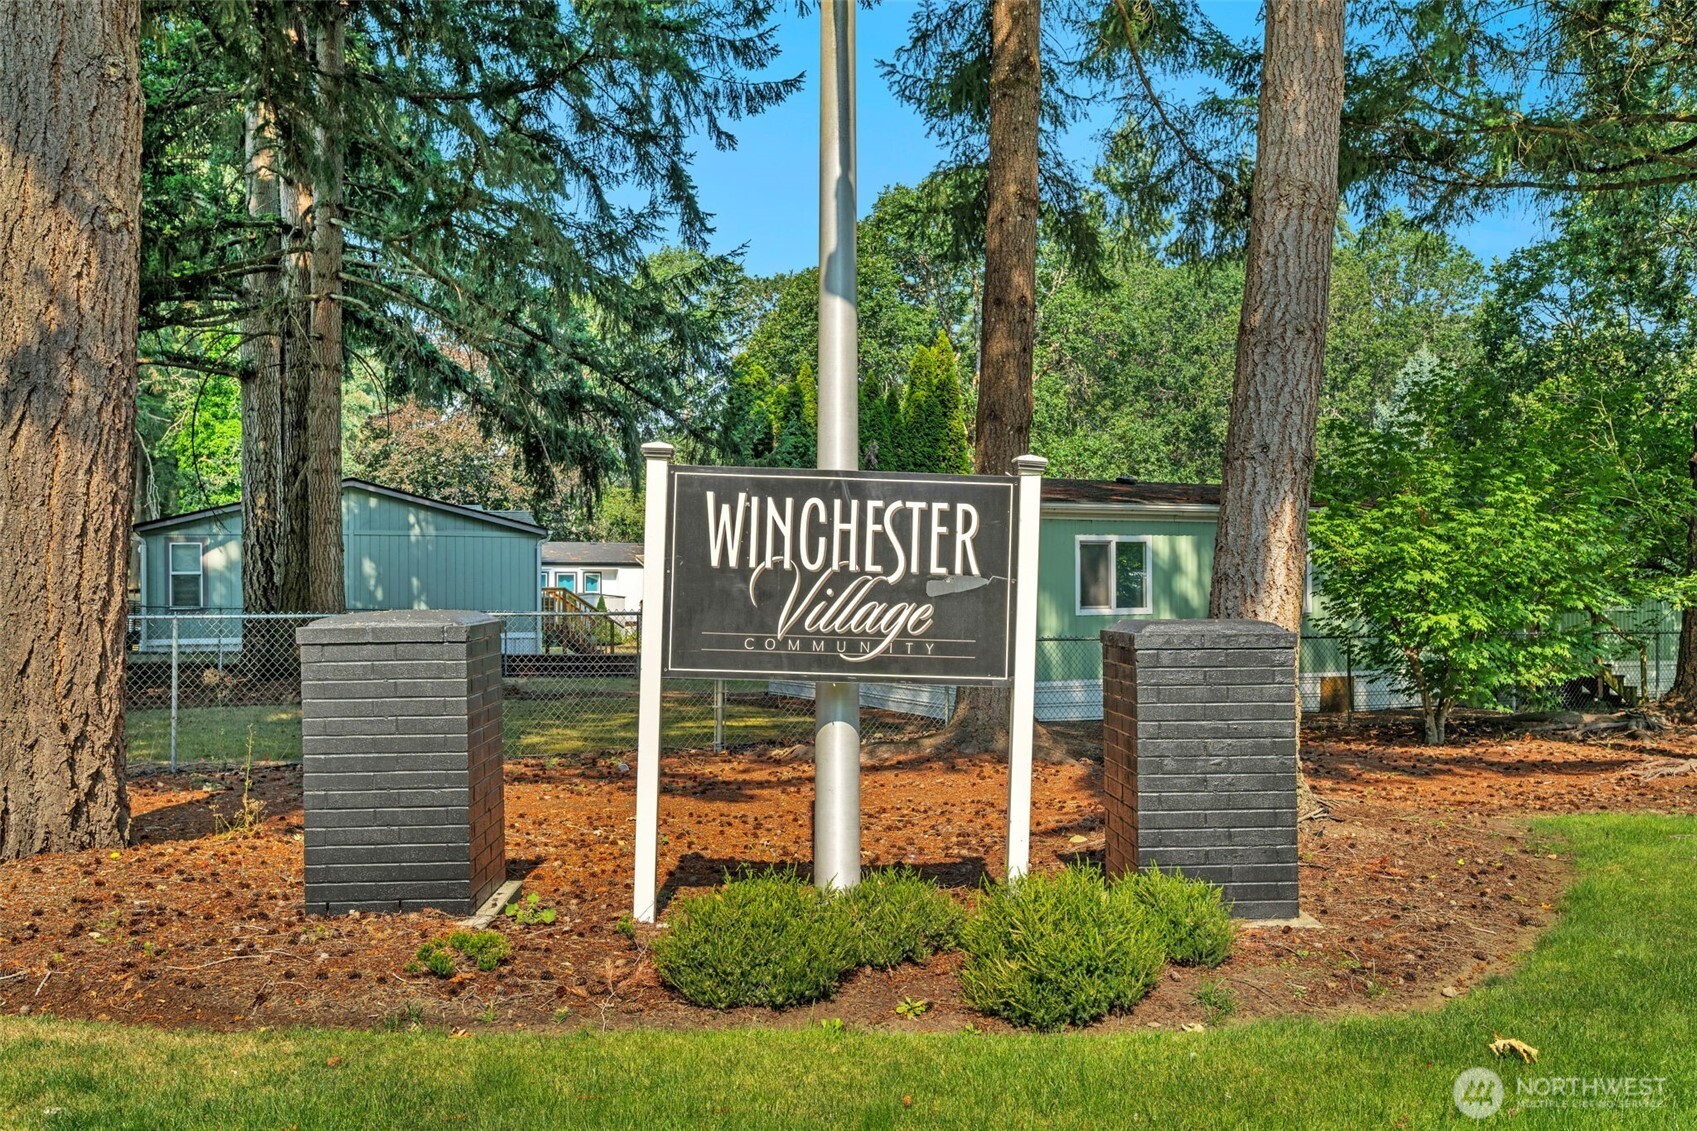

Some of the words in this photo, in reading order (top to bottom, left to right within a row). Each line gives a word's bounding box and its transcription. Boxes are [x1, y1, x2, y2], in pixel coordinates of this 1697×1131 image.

[706, 491, 981, 584] WINCHESTER
[744, 637, 935, 655] COMMUNITY
[749, 556, 935, 662] Village
